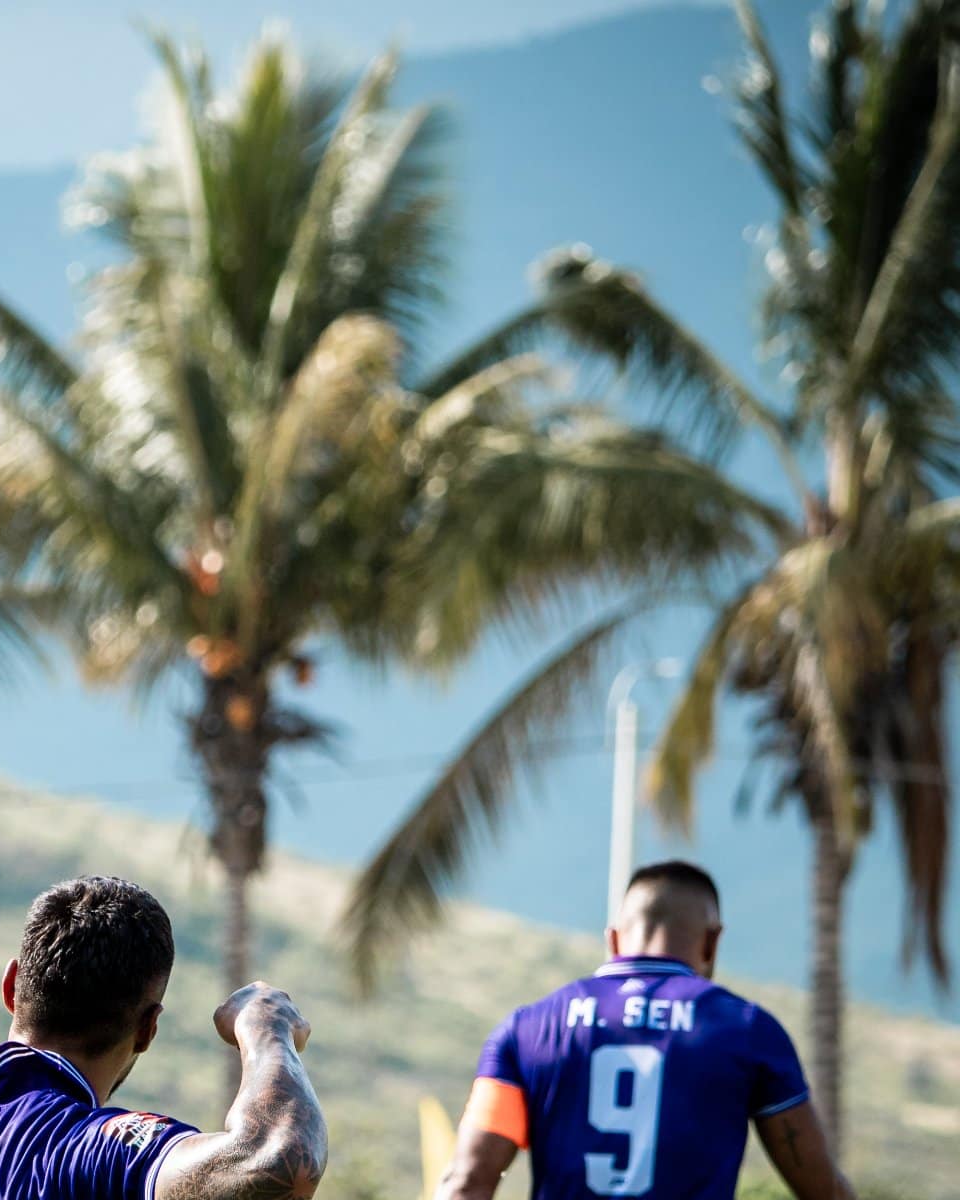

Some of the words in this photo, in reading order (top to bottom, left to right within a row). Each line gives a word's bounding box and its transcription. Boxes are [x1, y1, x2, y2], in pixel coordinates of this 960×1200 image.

[567, 997, 606, 1028] M.
[623, 996, 695, 1032] SEN
[584, 1044, 664, 1196] 9
